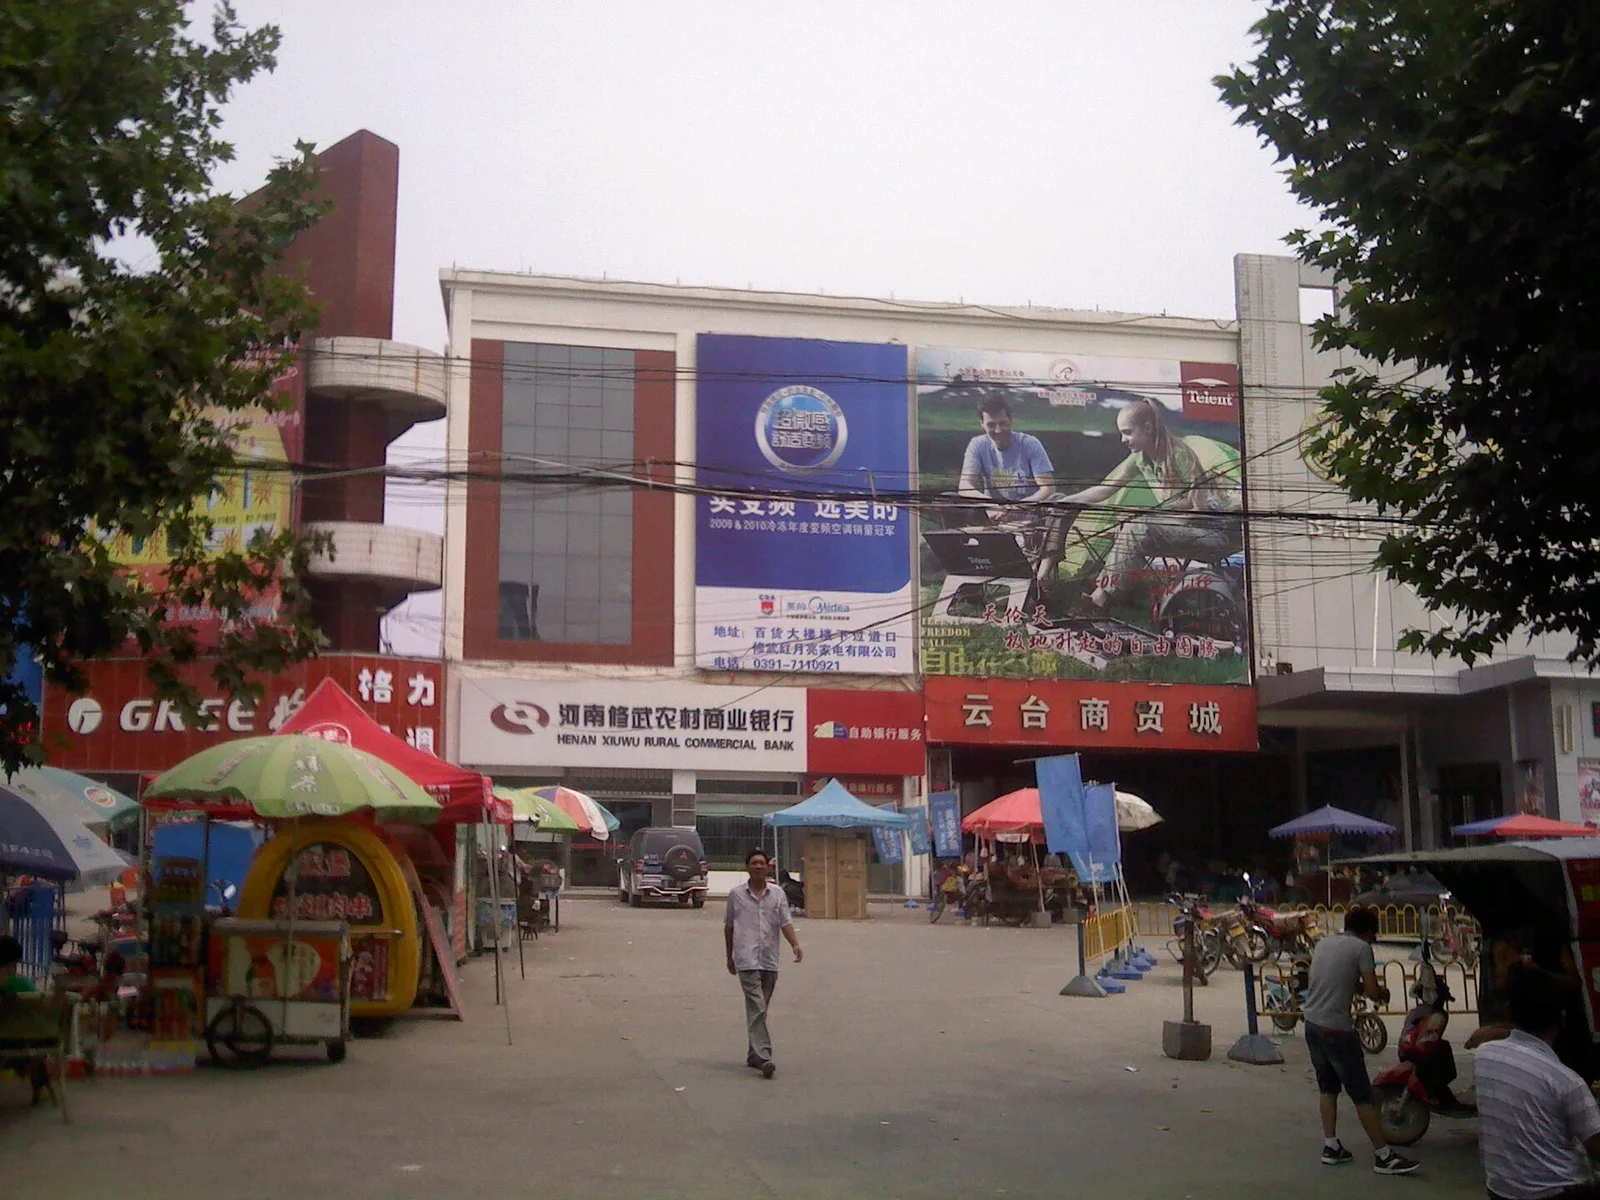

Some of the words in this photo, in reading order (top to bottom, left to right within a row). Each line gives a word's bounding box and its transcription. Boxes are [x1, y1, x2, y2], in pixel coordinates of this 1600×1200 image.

[1186, 390, 1234, 406] Telent
[815, 598, 850, 613] Midea
[920, 627, 971, 637] FREEDOM
[358, 666, 435, 707] 格力
[558, 703, 795, 733] 河南修武农村商业银行
[962, 693, 1223, 735] 云台商贸城
[849, 727, 922, 740] 自助银行服务
[557, 734, 597, 746] HENAN
[602, 735, 641, 748] XIUWU
[644, 737, 681, 749] RURAL
[684, 738, 758, 751] COMMERCIAL
[764, 740, 795, 752] BANK
